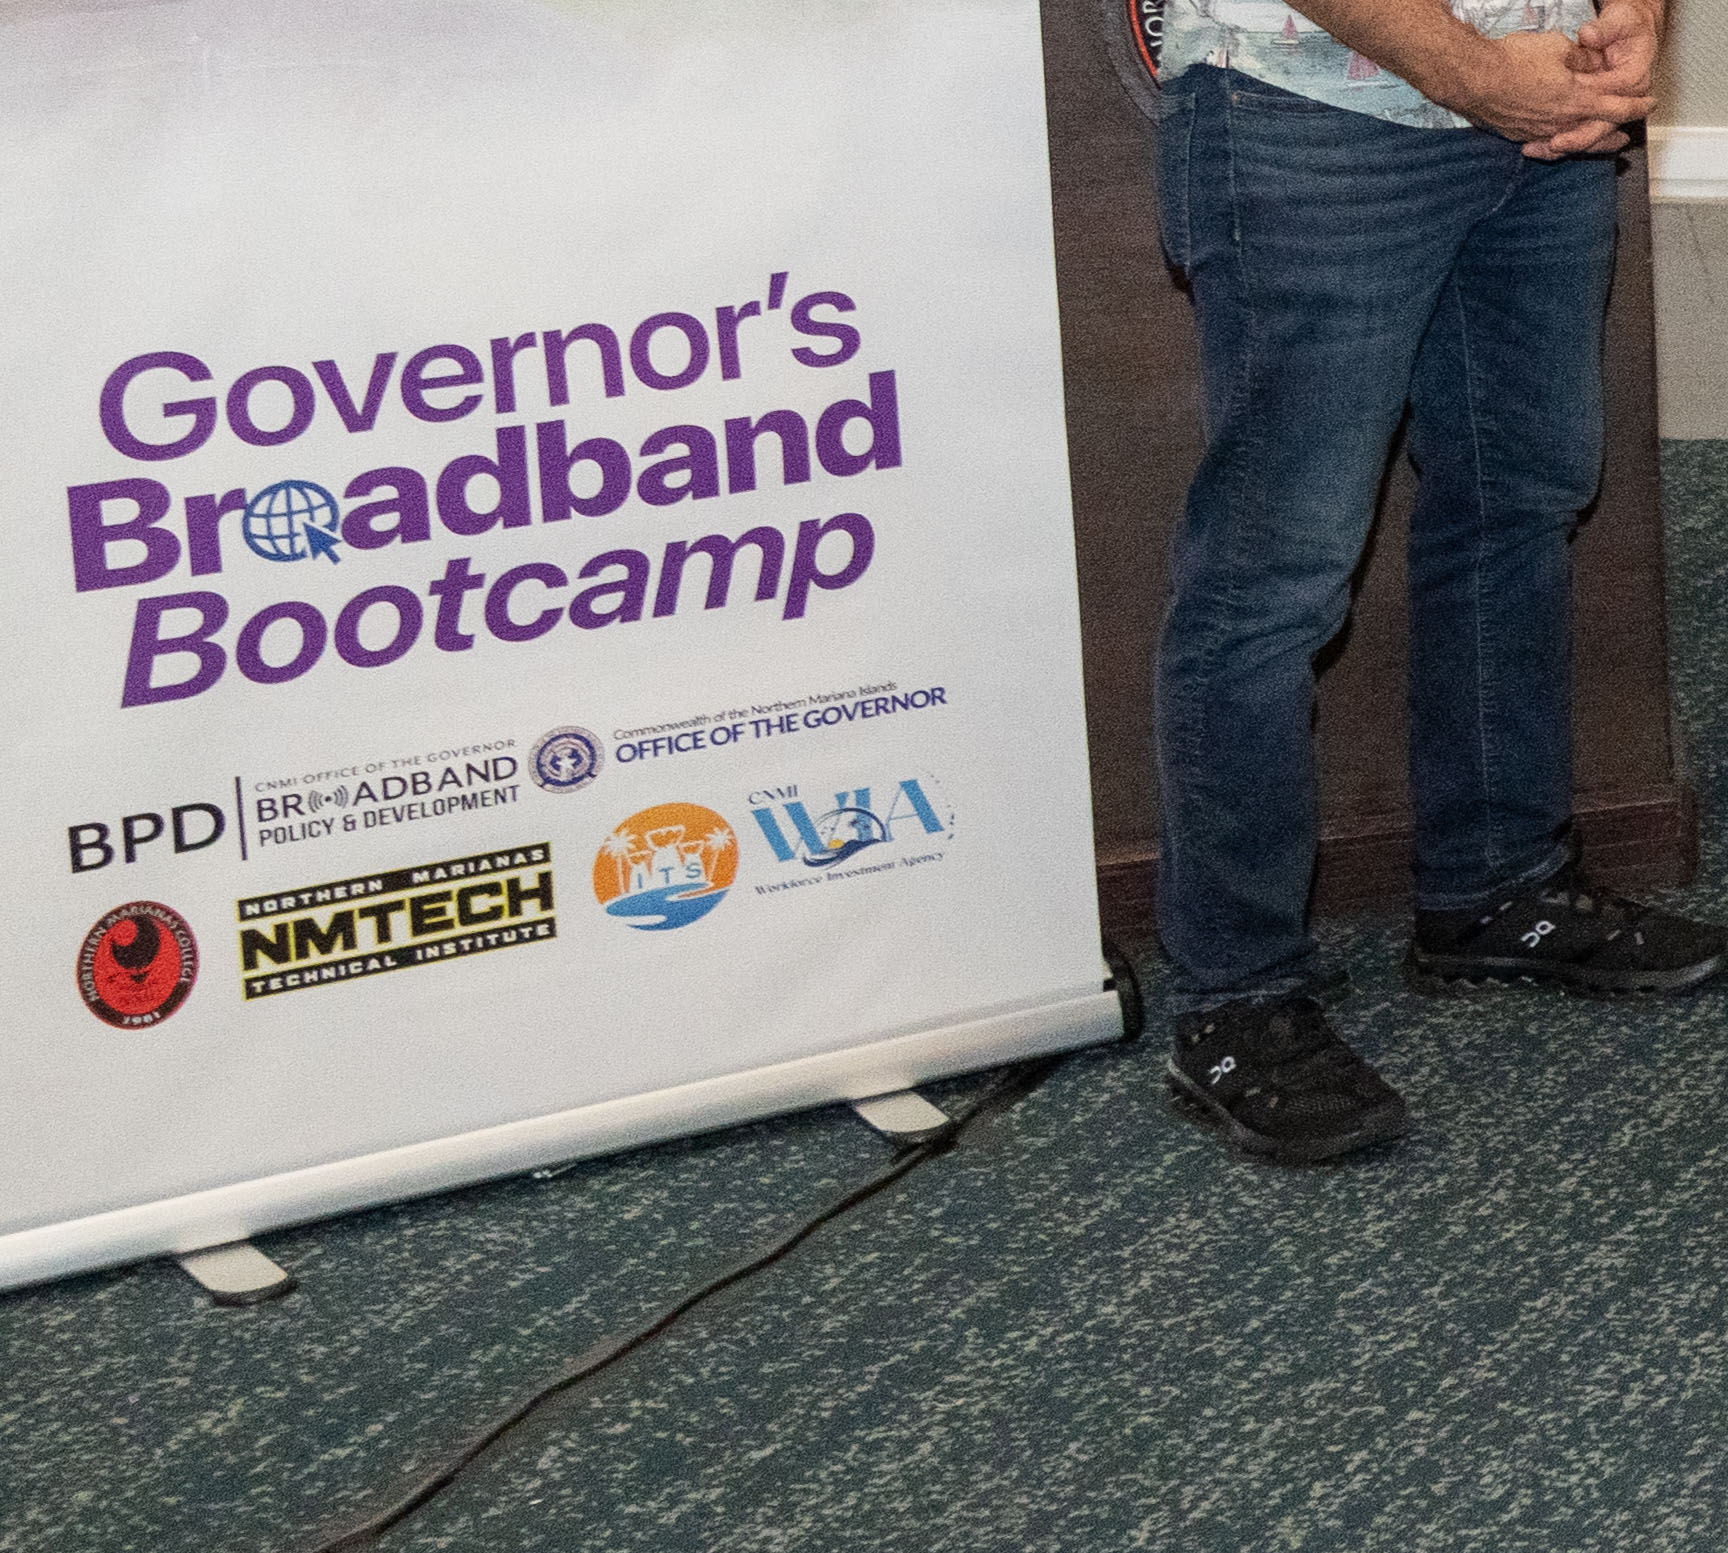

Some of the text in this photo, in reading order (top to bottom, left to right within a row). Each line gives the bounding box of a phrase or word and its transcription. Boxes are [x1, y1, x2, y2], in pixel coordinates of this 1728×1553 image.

[97, 271, 863, 463] Governor's
[119, 510, 875, 709] Bootcamp
[613, 681, 897, 741] Commonwealth of the Northern Mariana Islands
[616, 731, 706, 763] OFFICE
[710, 723, 746, 747] OF
[749, 713, 799, 739] THE
[803, 686, 947, 730] GOVERNOR
[255, 739, 516, 793] CNMI OFFICE OF THE GOVERNOR
[68, 802, 226, 873] BPD
[259, 785, 521, 848] POLICY & DEVELOPMENT
[244, 848, 546, 916] NORTHERN MARIANAS
[637, 863, 703, 891] ITS
[898, 851, 946, 872] Agency
[240, 870, 554, 971] NMTECH
[252, 923, 551, 994] TECHNICAL INSTITUTE
